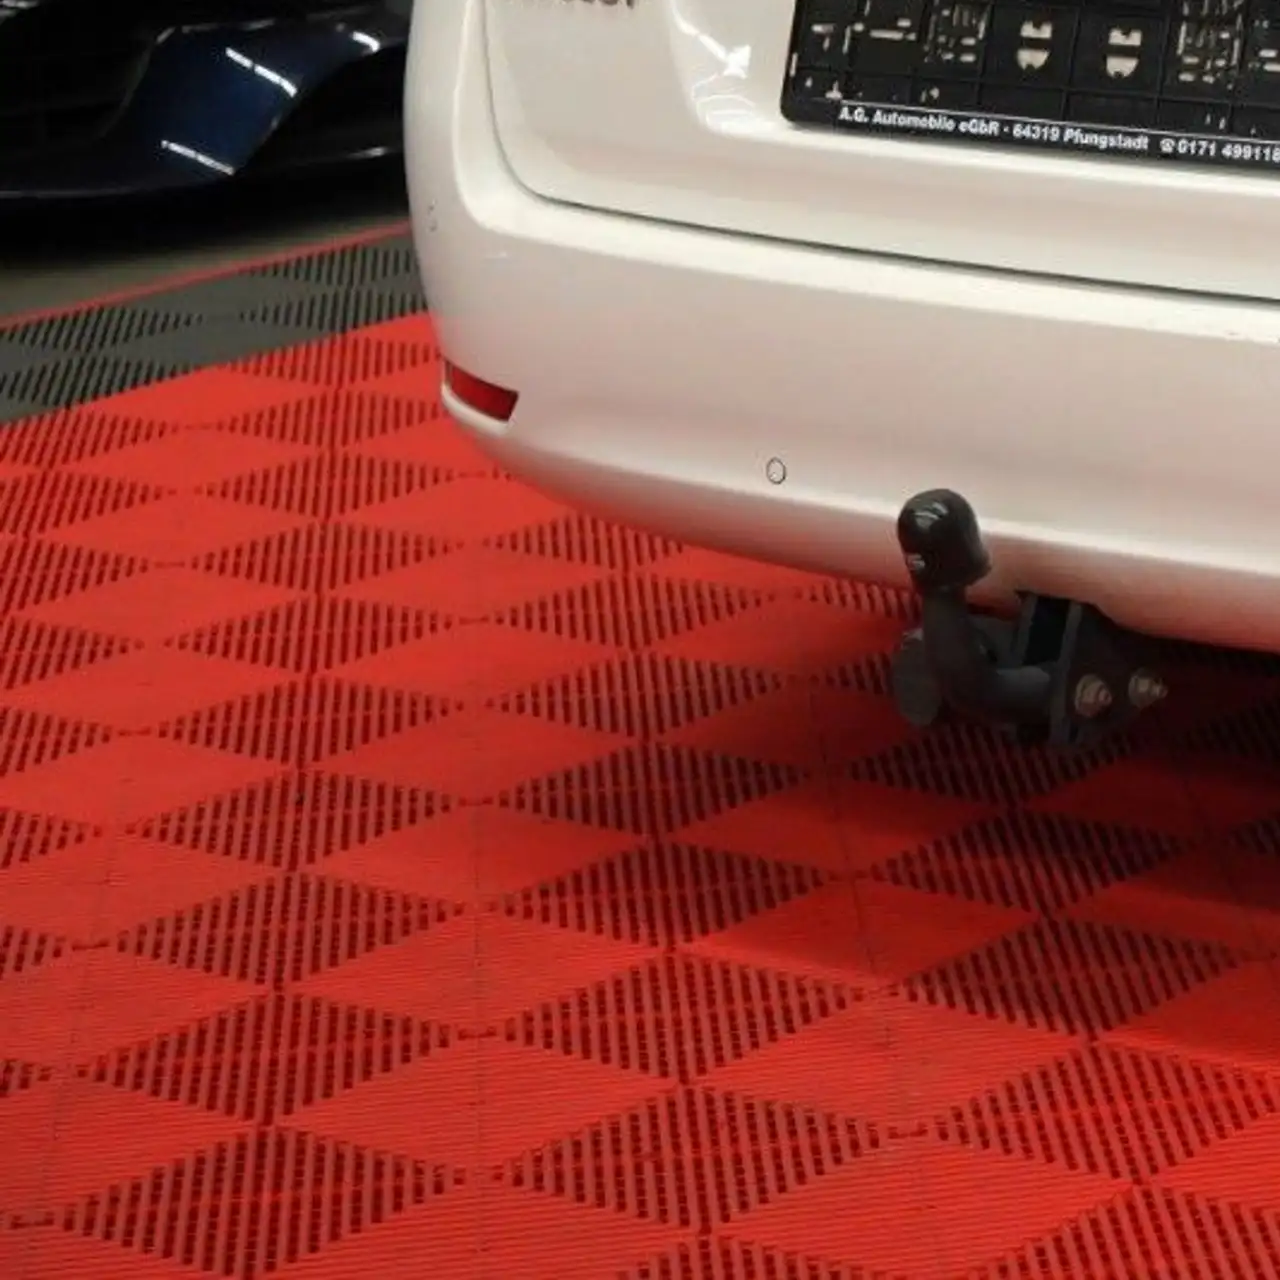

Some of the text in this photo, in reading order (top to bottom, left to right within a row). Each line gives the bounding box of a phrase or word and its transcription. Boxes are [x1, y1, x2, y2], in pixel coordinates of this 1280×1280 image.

[872, 110, 954, 131] Automobile
[1012, 123, 1059, 141] 64319
[1063, 127, 1149, 150] Pfungstadt
[1178, 137, 1216, 157] 0171
